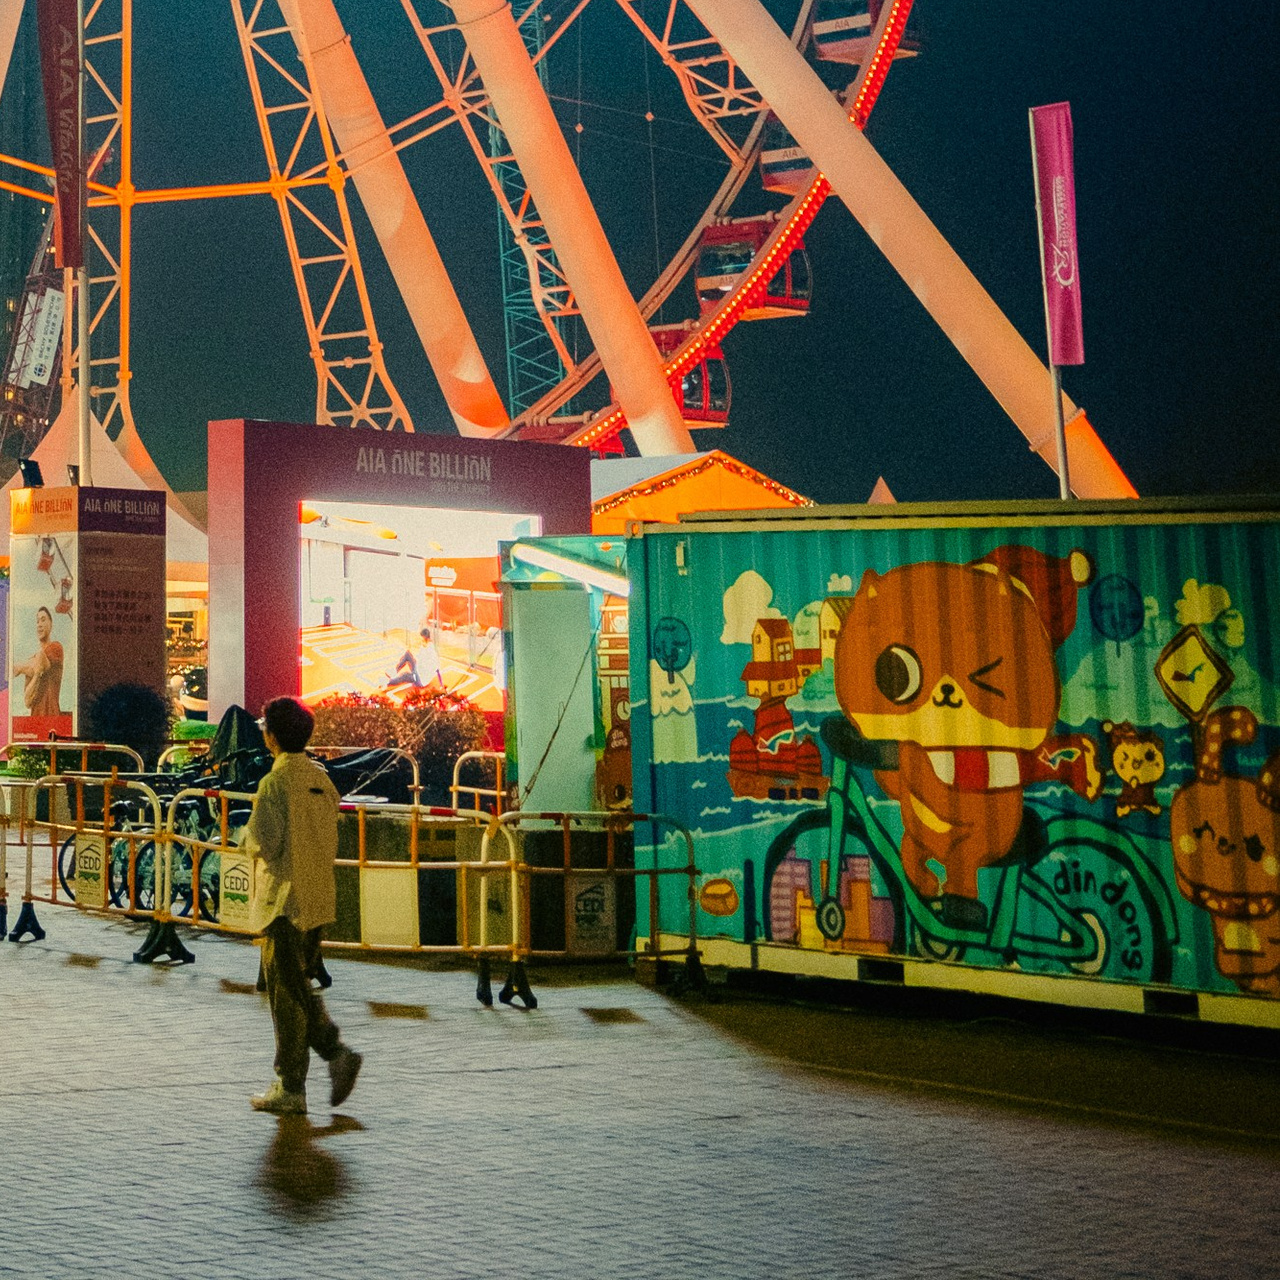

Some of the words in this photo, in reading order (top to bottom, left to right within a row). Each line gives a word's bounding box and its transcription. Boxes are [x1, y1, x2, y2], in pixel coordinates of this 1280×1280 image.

[57, 23, 74, 101] AIA
[356, 446, 387, 474] AIA
[84, 497, 102, 513] AIA
[78, 855, 101, 871] CEDD
[223, 875, 250, 892] CEDD
